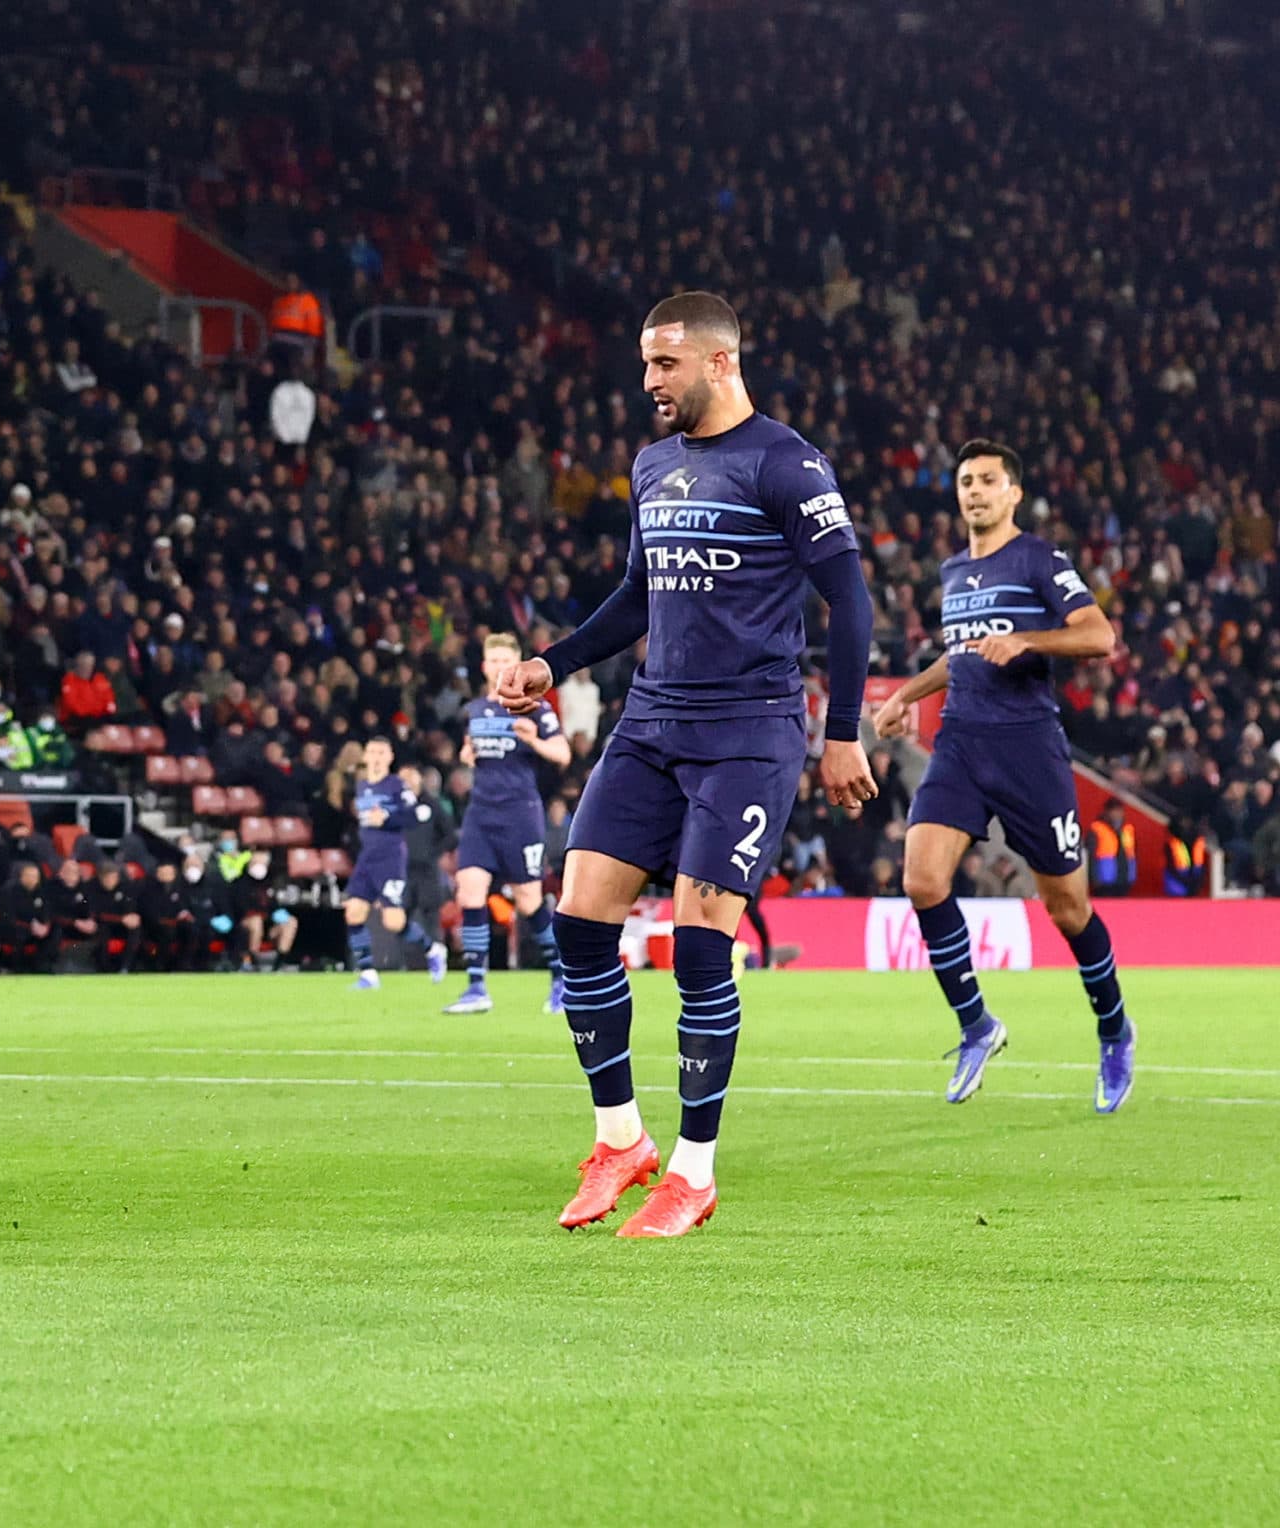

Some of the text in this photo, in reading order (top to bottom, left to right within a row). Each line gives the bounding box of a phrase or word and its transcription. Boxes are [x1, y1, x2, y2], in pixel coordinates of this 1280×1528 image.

[674, 509, 721, 529] CITY
[645, 546, 741, 571] TIHAD
[648, 576, 714, 592] AIRWAYS
[968, 592, 998, 610] CITY
[733, 804, 767, 858] 2
[1051, 809, 1081, 852] 16
